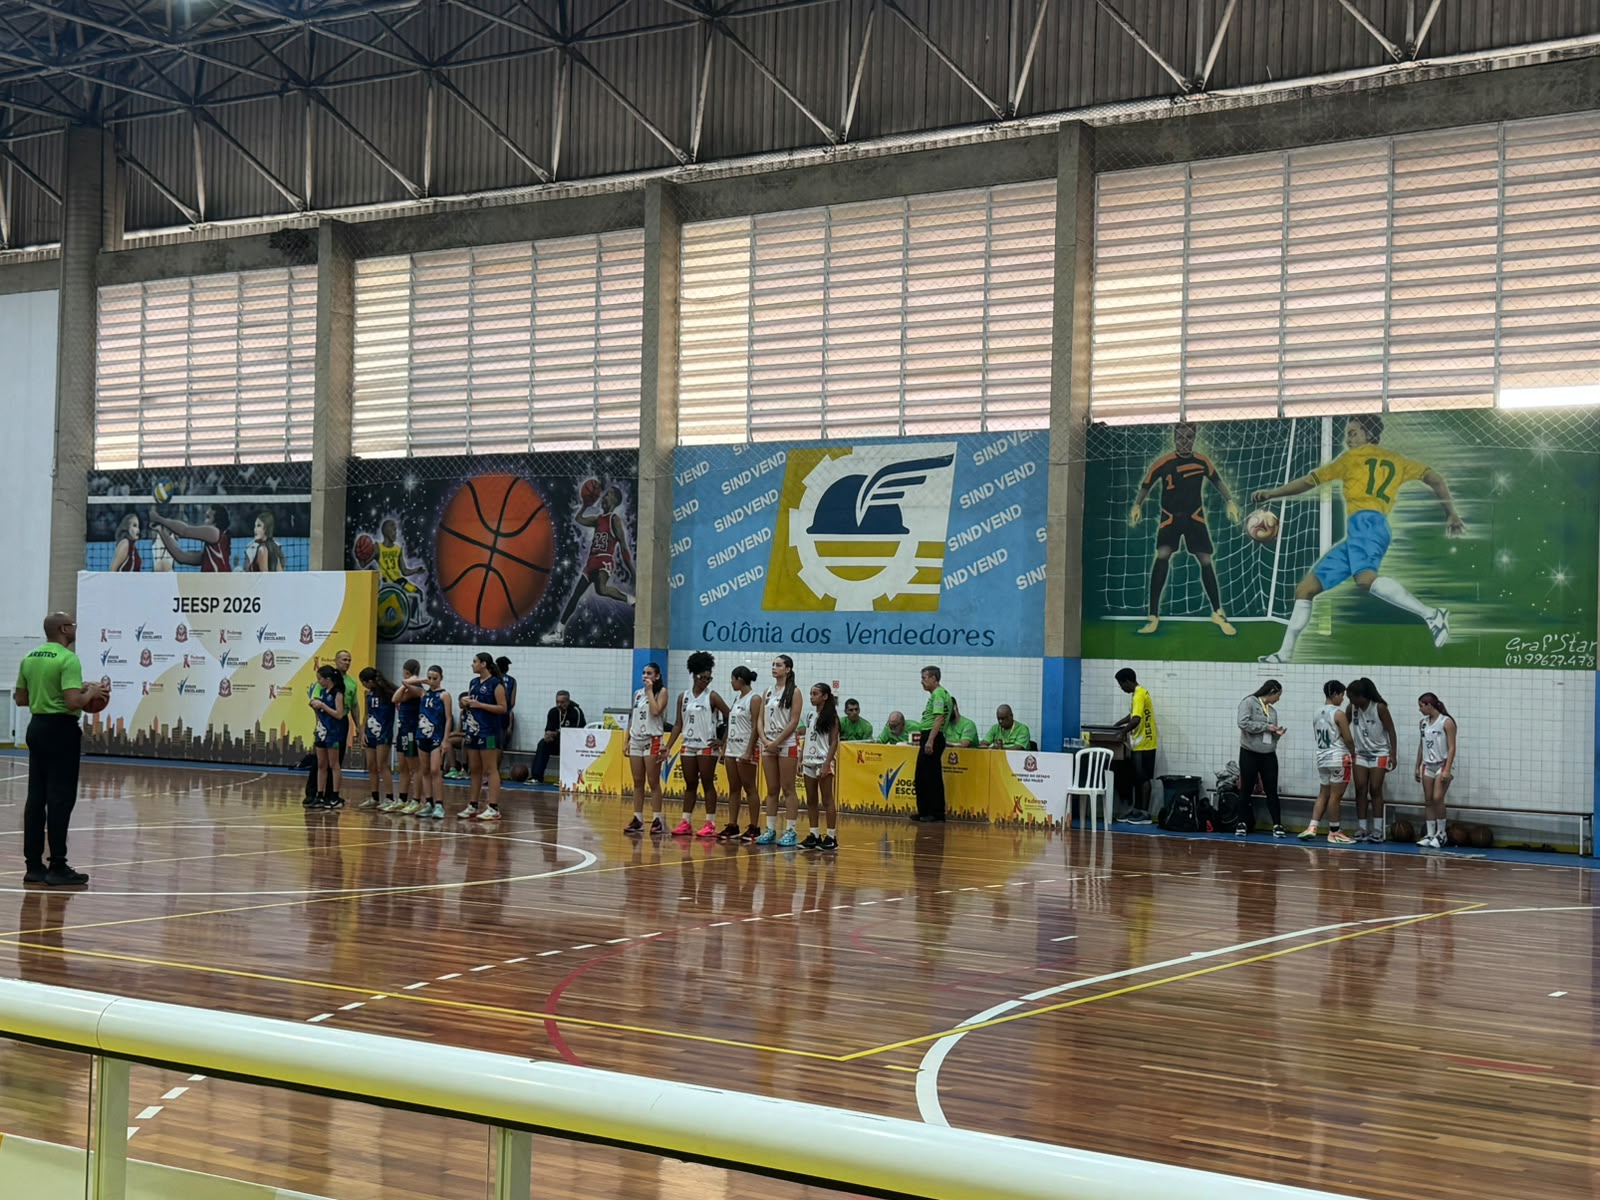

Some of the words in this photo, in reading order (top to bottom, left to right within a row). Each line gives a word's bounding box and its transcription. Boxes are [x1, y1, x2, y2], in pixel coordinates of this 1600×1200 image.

[675, 461, 710, 487] VEND
[1166, 474, 1175, 490] 1
[1365, 458, 1396, 504] 12
[172, 597, 219, 613] JEESP
[223, 597, 261, 613] 2026
[702, 620, 783, 643] Colônia
[791, 622, 832, 644] dos
[846, 621, 995, 647] Vendedores
[1505, 653, 1522, 665] (13)
[424, 698, 434, 708] 14
